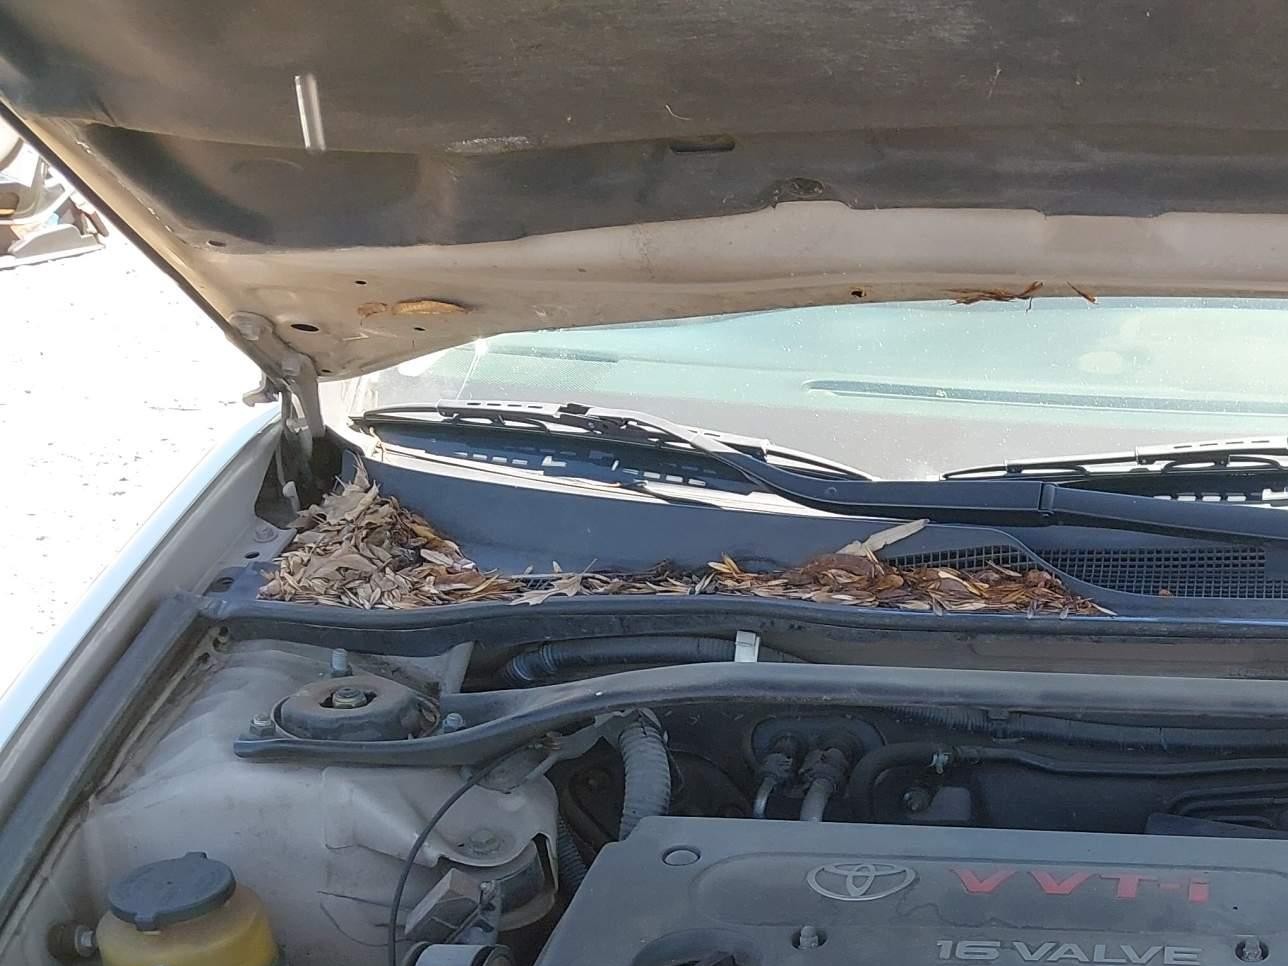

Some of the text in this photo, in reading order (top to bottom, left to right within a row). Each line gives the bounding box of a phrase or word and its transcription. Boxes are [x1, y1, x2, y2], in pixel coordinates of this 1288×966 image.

[948, 867, 1210, 904] VVT-i
[936, 940, 1202, 966] 16 VALVE
